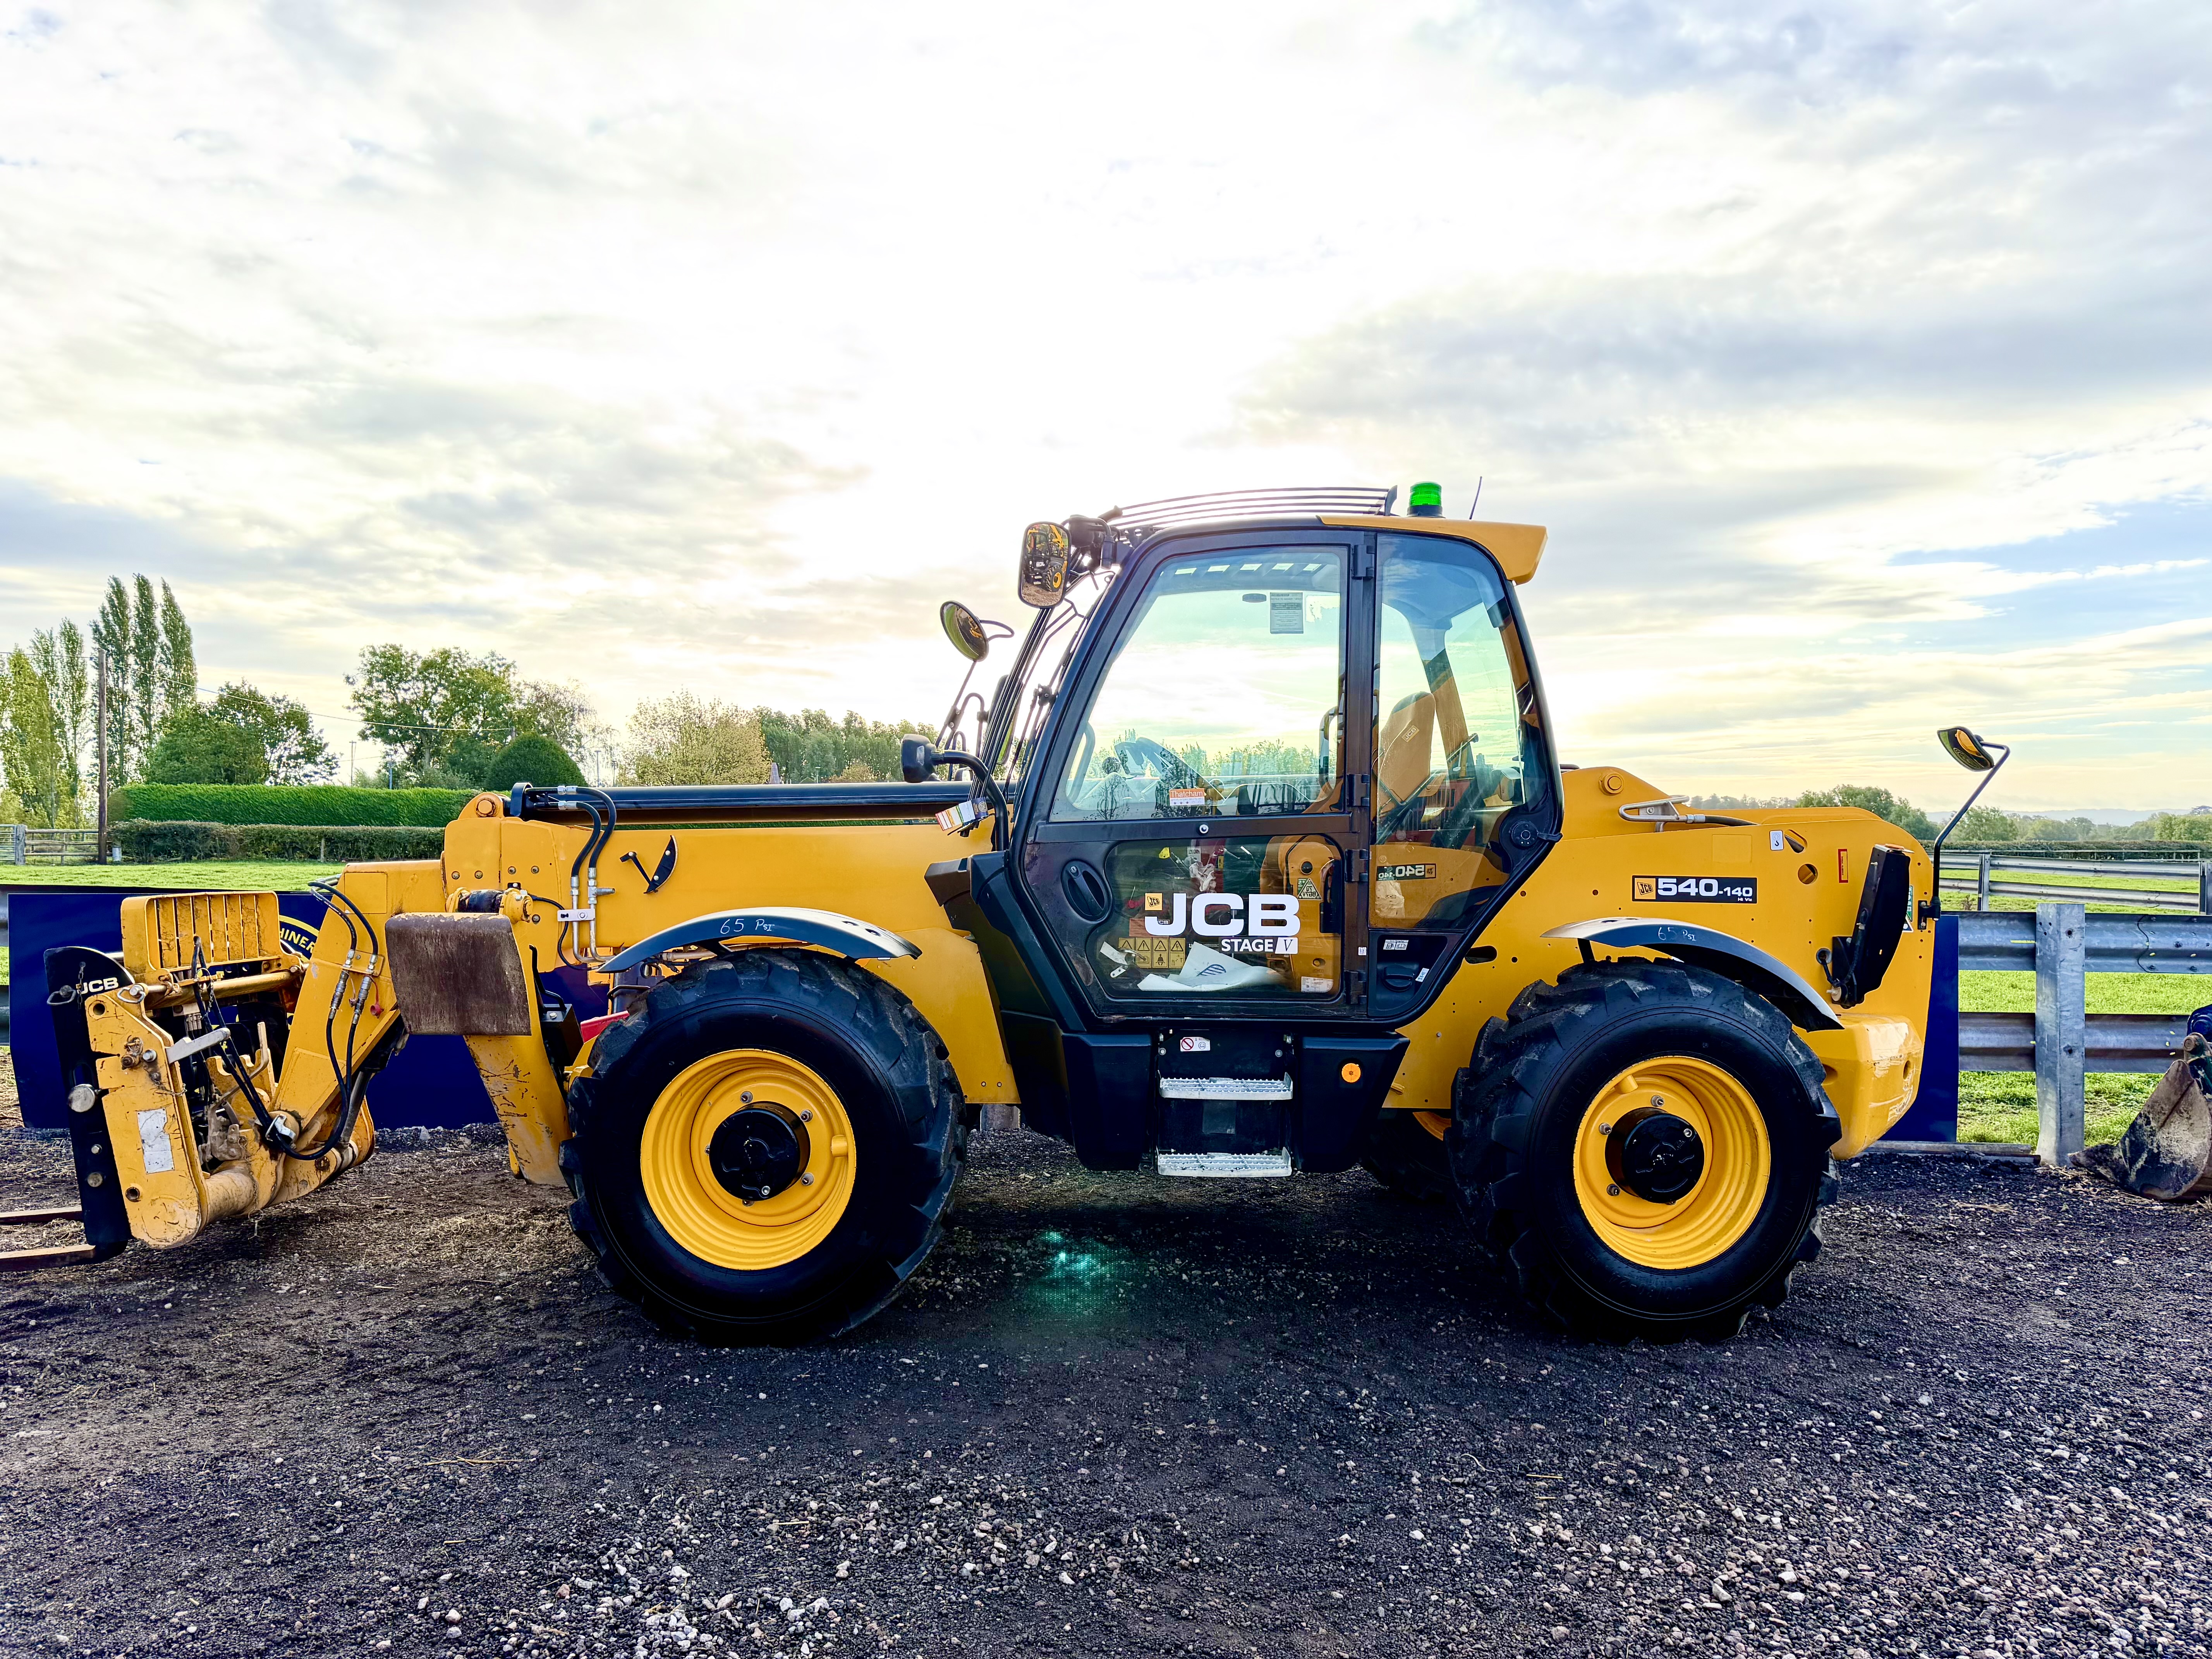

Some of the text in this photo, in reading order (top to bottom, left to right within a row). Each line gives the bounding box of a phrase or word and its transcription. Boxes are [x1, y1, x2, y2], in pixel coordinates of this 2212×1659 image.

[1404, 727, 1416, 740] JCB
[1639, 883, 1652, 894] JCB
[1657, 878, 1753, 896] 540-140
[1149, 896, 1159, 906] JCB
[1144, 893, 1300, 936] JCB
[720, 919, 744, 934] 65
[1657, 927, 1678, 941] 65
[1221, 939, 1293, 952] STAGE V
[76, 977, 119, 994] JCB
